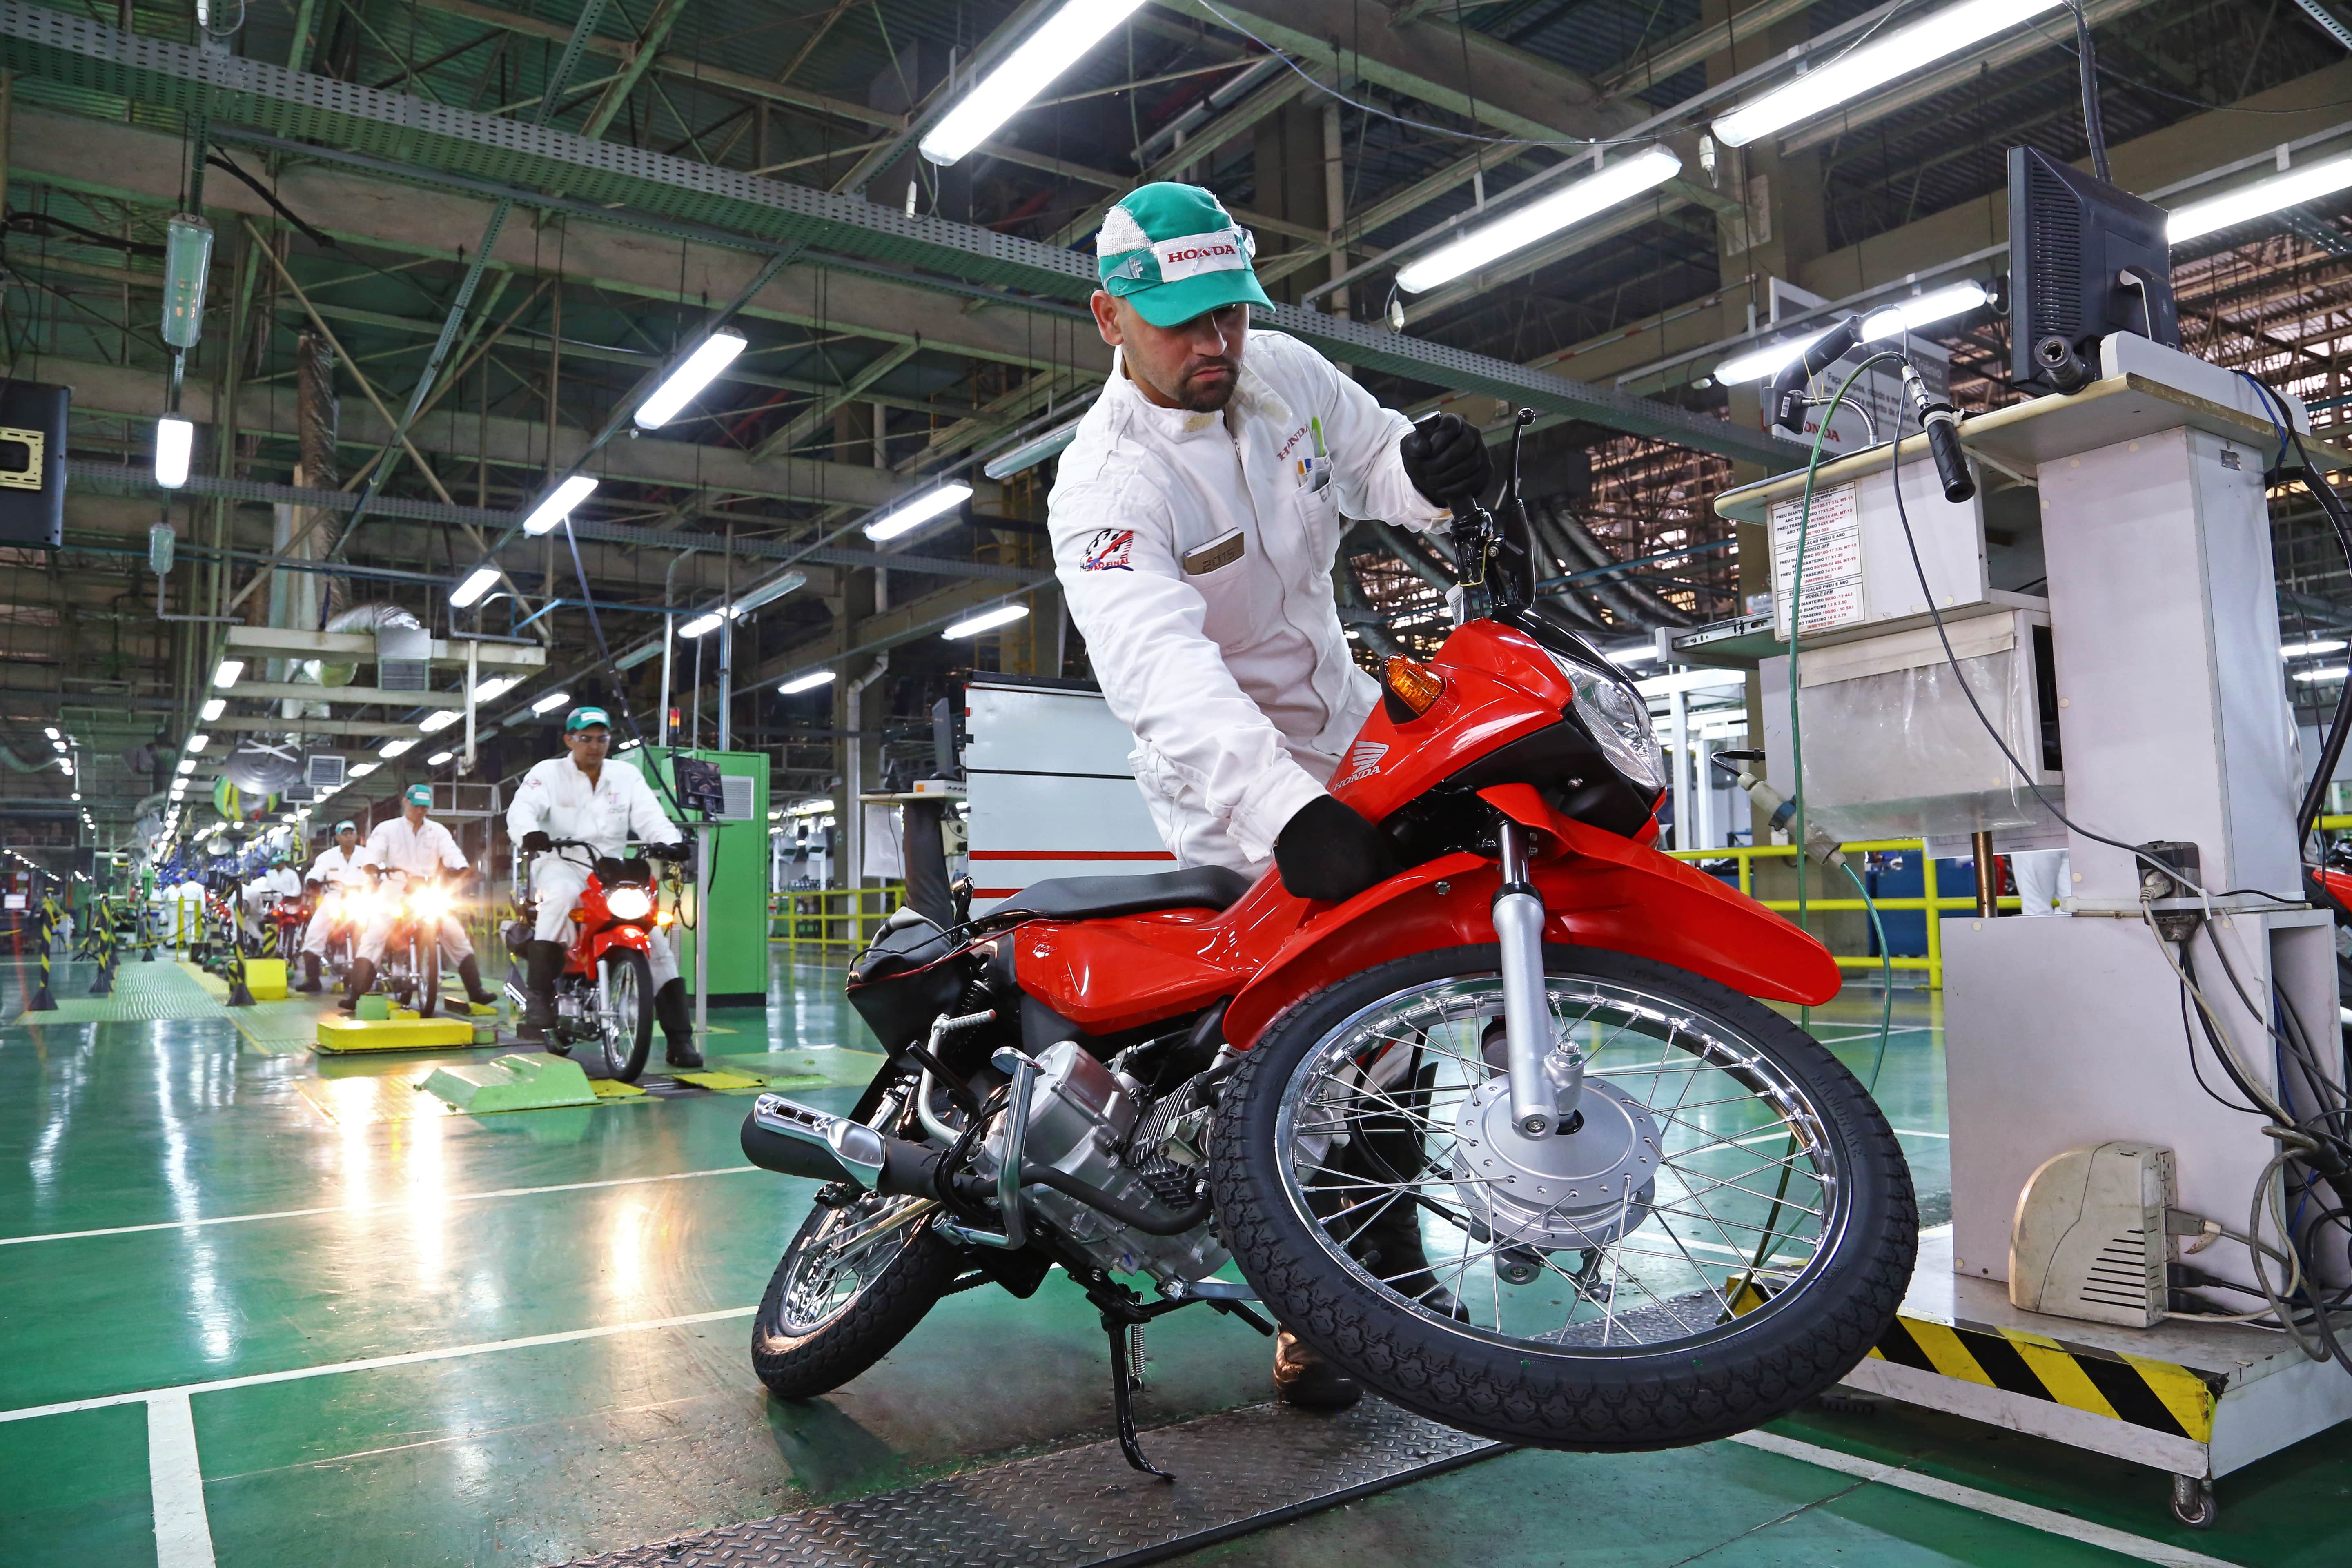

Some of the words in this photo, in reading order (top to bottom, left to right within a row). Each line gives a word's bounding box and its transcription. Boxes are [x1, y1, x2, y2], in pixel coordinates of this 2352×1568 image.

[1167, 245, 1236, 263] HONDA
[1804, 421, 1840, 442] ONDA
[1795, 512, 1817, 520] DIAIRO
[1789, 519, 1810, 528] TRASO
[1797, 524, 1817, 533] TEIRO
[1106, 558, 1130, 567] FINAL
[1203, 547, 1235, 572] 2015
[1802, 558, 1824, 566] DIANTEIRO
[1789, 586, 1822, 596] ESCIFICAÇAO
[1332, 765, 1381, 792] HONDA
